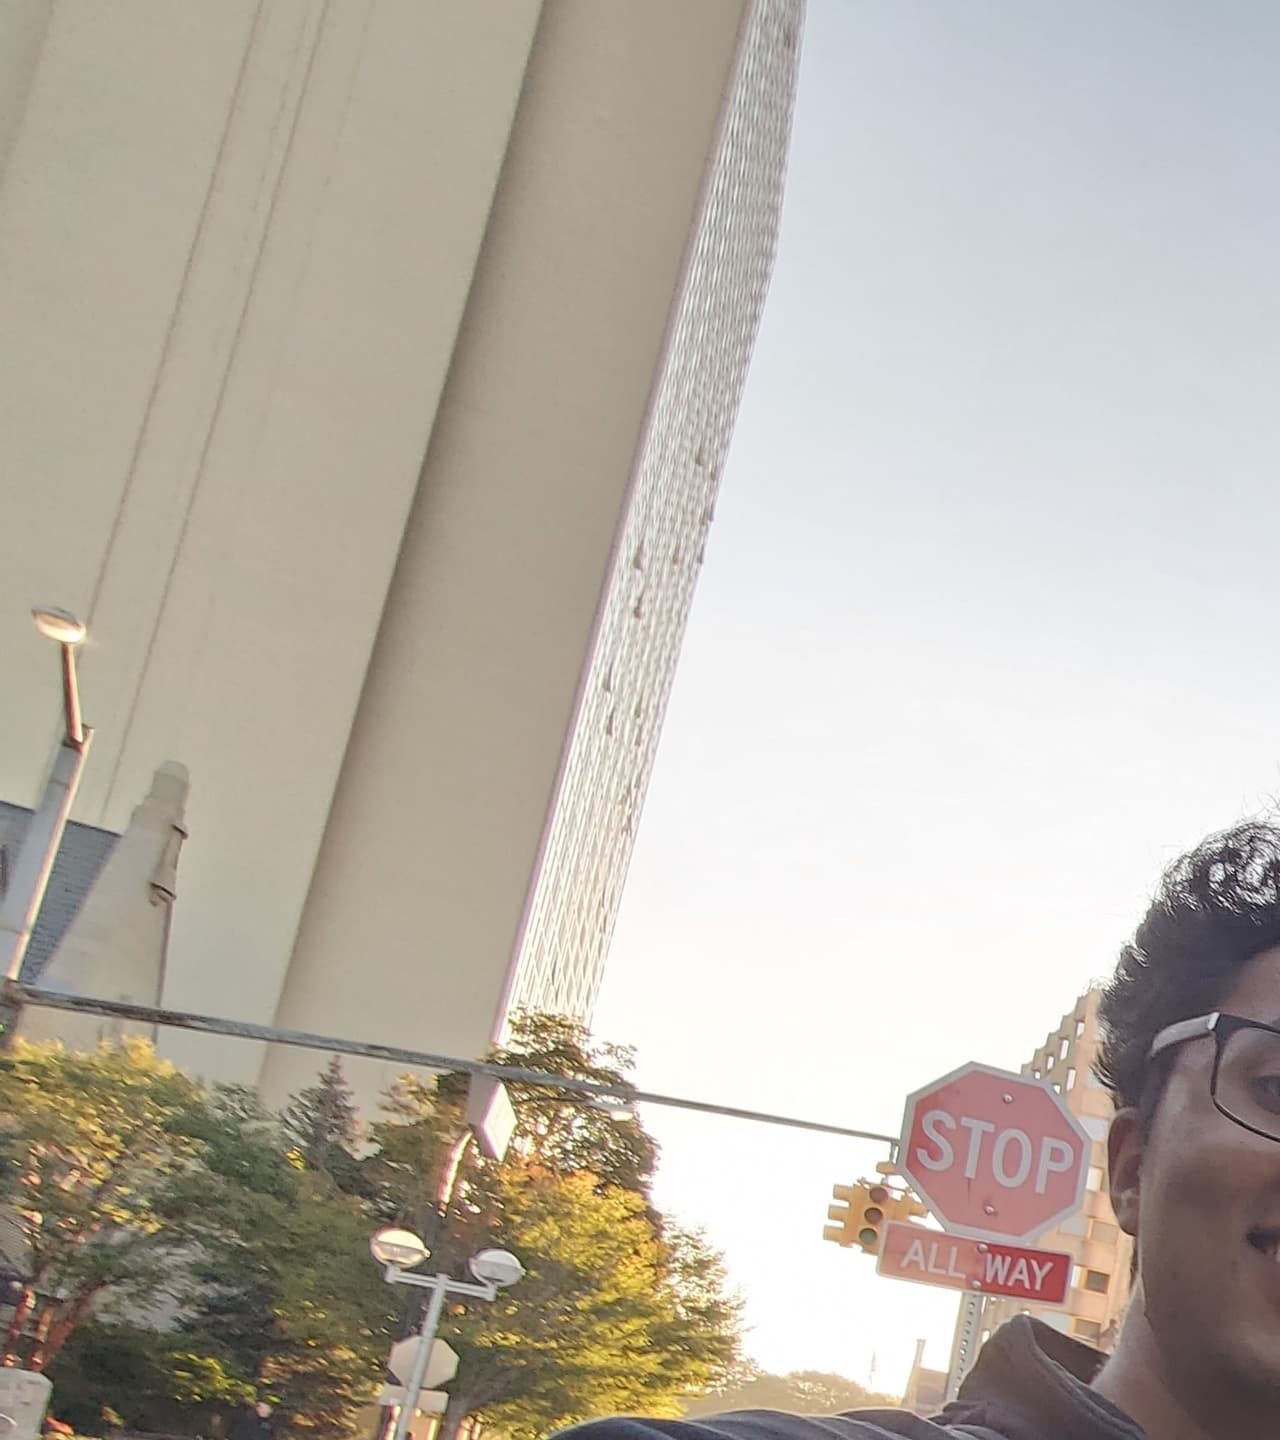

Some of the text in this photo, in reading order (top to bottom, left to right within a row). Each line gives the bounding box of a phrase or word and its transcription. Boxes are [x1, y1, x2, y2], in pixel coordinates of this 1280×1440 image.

[915, 1109, 1075, 1195] STOP
[900, 1239, 1054, 1292] ALL WAY
